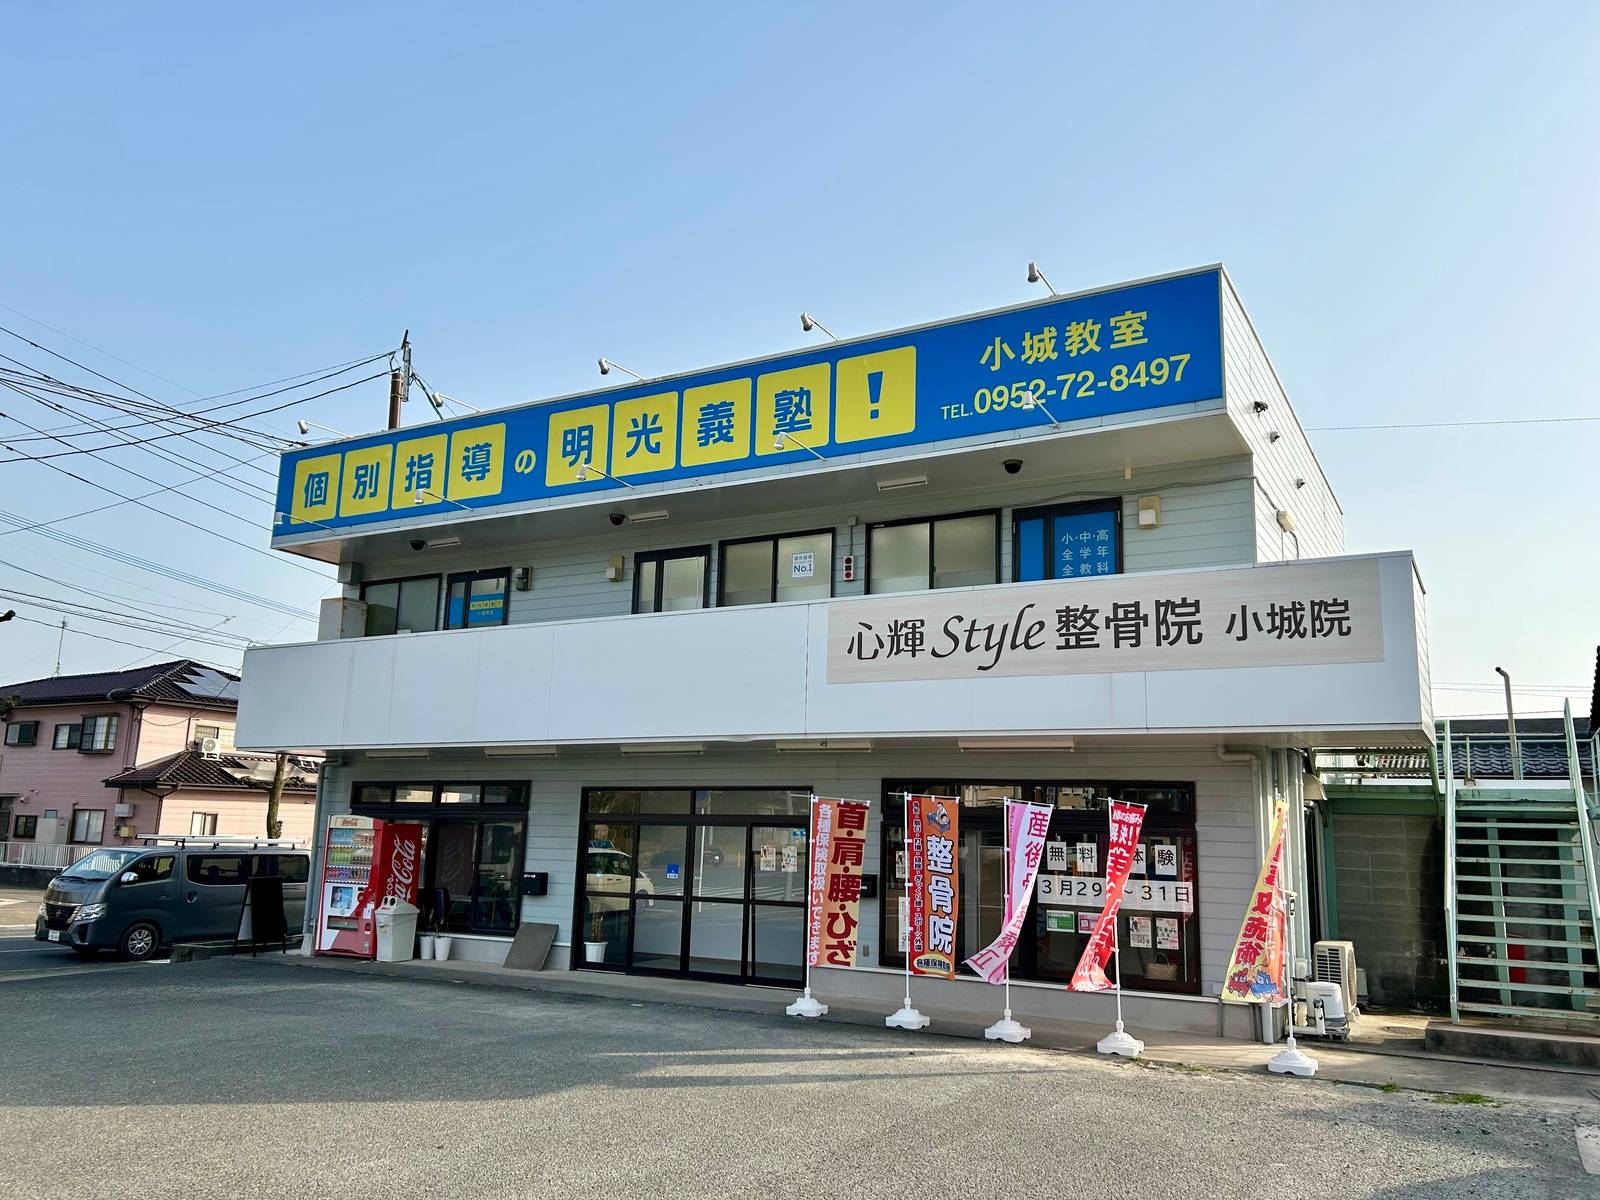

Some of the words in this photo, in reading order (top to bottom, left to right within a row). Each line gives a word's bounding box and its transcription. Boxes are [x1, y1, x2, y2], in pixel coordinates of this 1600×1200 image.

[980, 310, 1148, 372] 小城教室
[974, 353, 1191, 414] 0952-72-8497
[1061, 546, 1109, 561] 全学年
[1061, 561, 1109, 577] 全教科
[1225, 597, 1352, 642] 小城院
[825, 801, 870, 967] 首・肩・腰・ひざ
[927, 834, 955, 955] 整骨院
